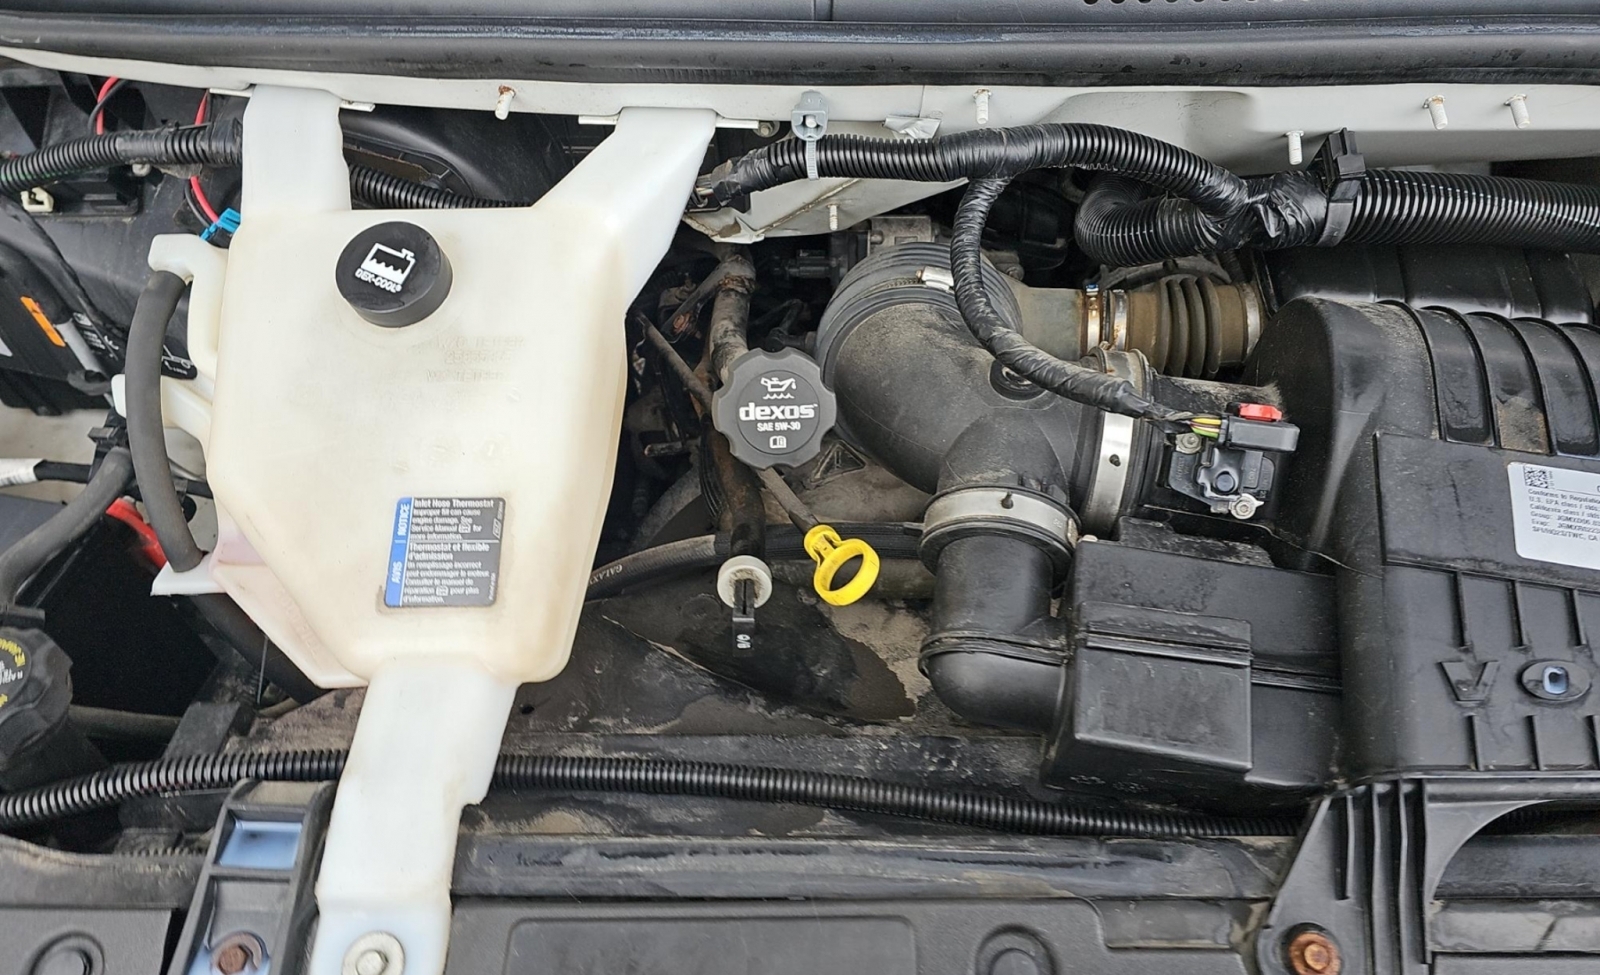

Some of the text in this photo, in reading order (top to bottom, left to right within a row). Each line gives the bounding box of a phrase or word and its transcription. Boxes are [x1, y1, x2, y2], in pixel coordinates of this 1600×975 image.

[738, 402, 815, 420] dexos
[757, 422, 801, 432] SAE 5W-30
[1528, 489, 1559, 498] Conforms
[414, 499, 494, 508] Inlet Hose Thermostat
[1530, 503, 1561, 513] California
[413, 508, 441, 516] Improper
[397, 503, 410, 536] NOTICE
[410, 542, 490, 552] Thermostat et flexible
[408, 552, 453, 560] d'admission
[392, 561, 402, 584] AVIS
[420, 570, 460, 578] endommager
